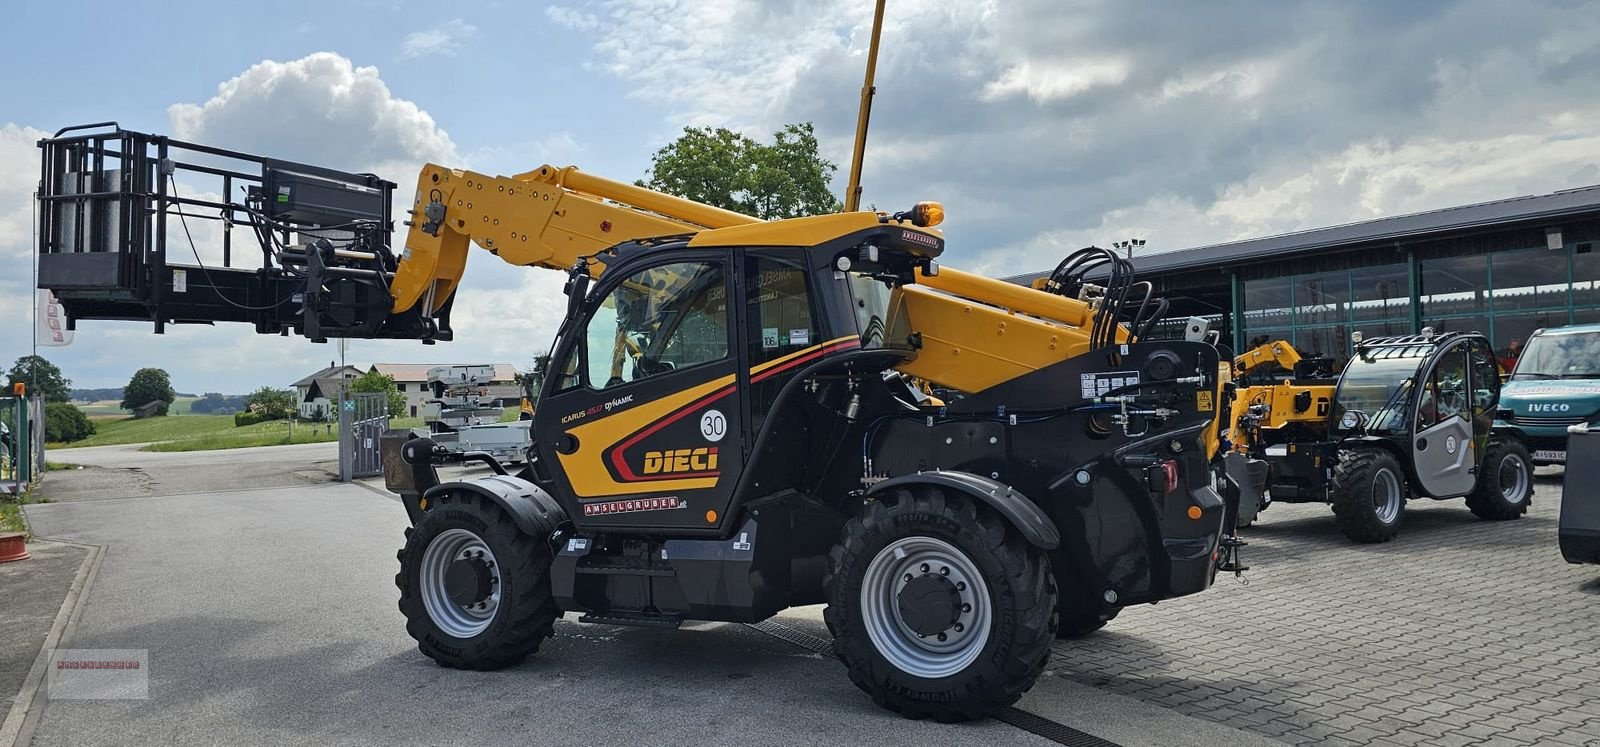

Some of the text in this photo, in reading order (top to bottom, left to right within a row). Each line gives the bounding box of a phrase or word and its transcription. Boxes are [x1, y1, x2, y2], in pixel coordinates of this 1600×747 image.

[561, 410, 586, 424] ICARUS
[604, 395, 633, 412] DYNAMIC
[1528, 403, 1569, 412] IVECO
[703, 415, 724, 437] 30
[643, 447, 719, 474] DIECI
